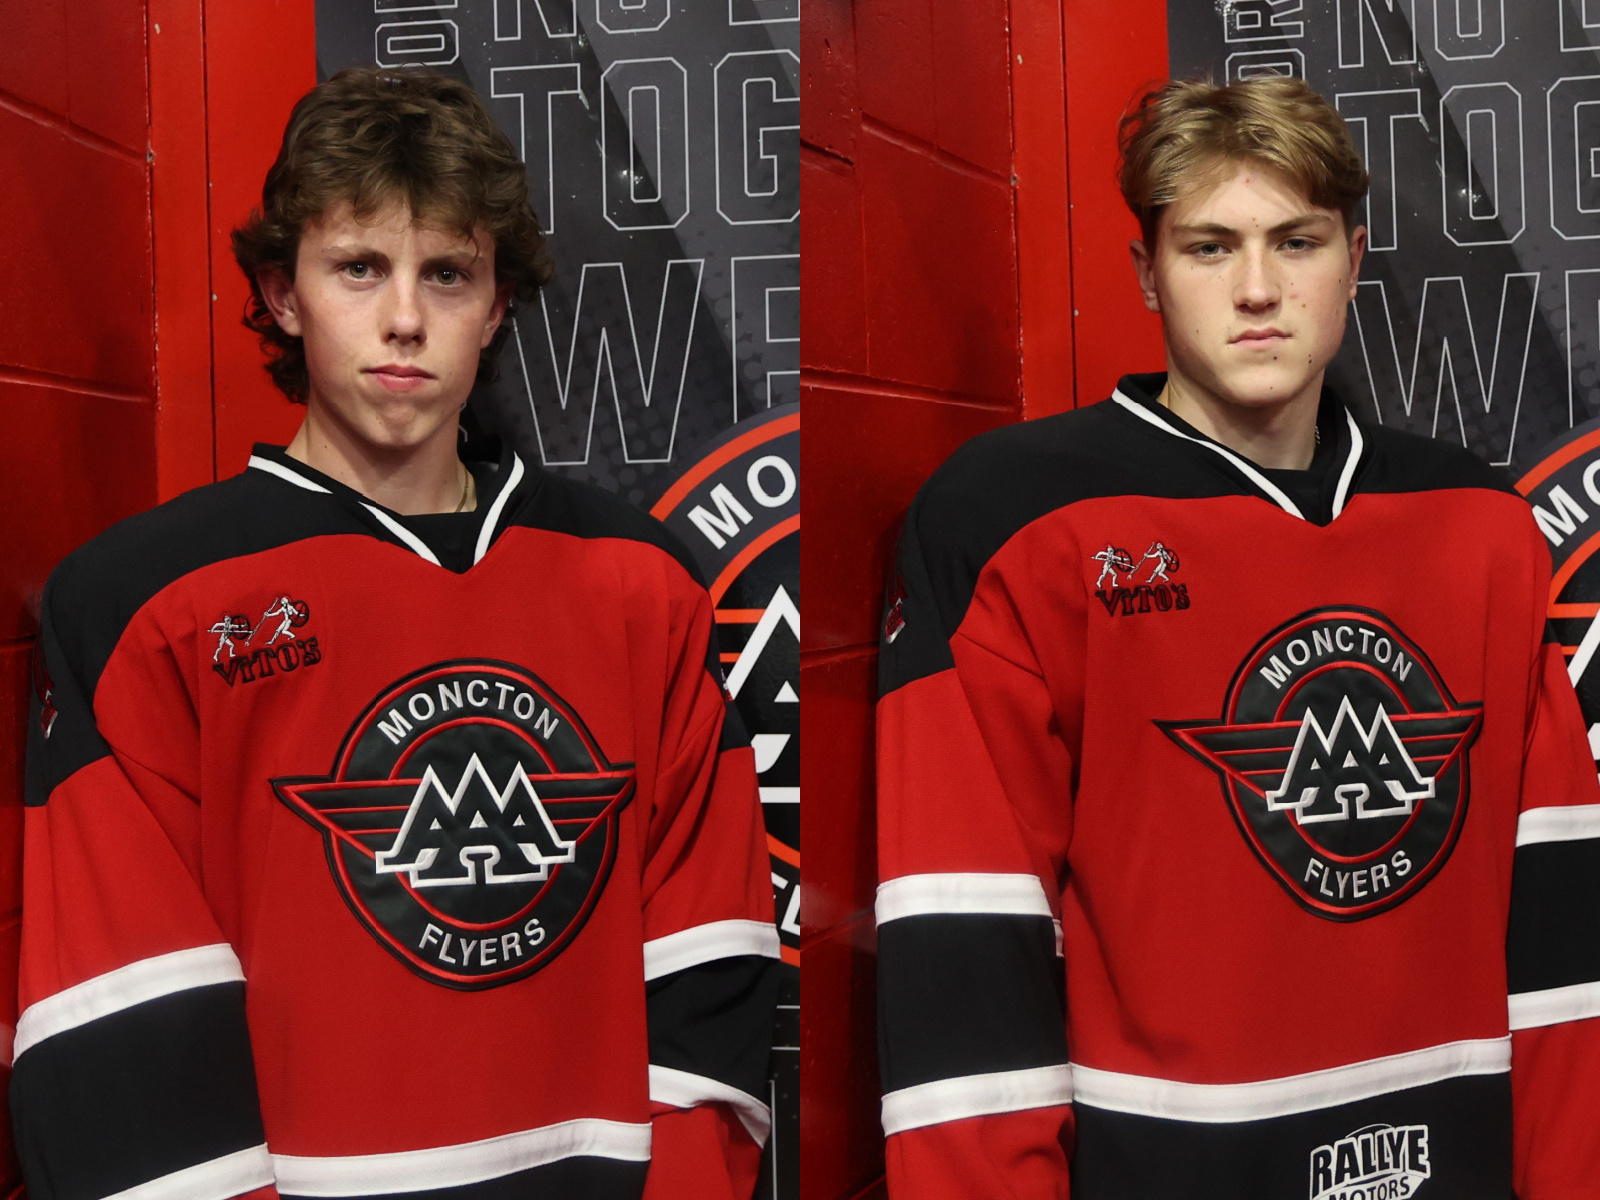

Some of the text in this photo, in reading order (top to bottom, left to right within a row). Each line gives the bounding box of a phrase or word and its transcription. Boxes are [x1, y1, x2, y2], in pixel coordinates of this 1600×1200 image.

[1259, 625, 1413, 689] MONCTON
[377, 679, 559, 745] MONCTON
[1304, 850, 1412, 899] FLYERS
[419, 918, 546, 967] FLYERS
[1310, 1125, 1430, 1199] RALLYE
